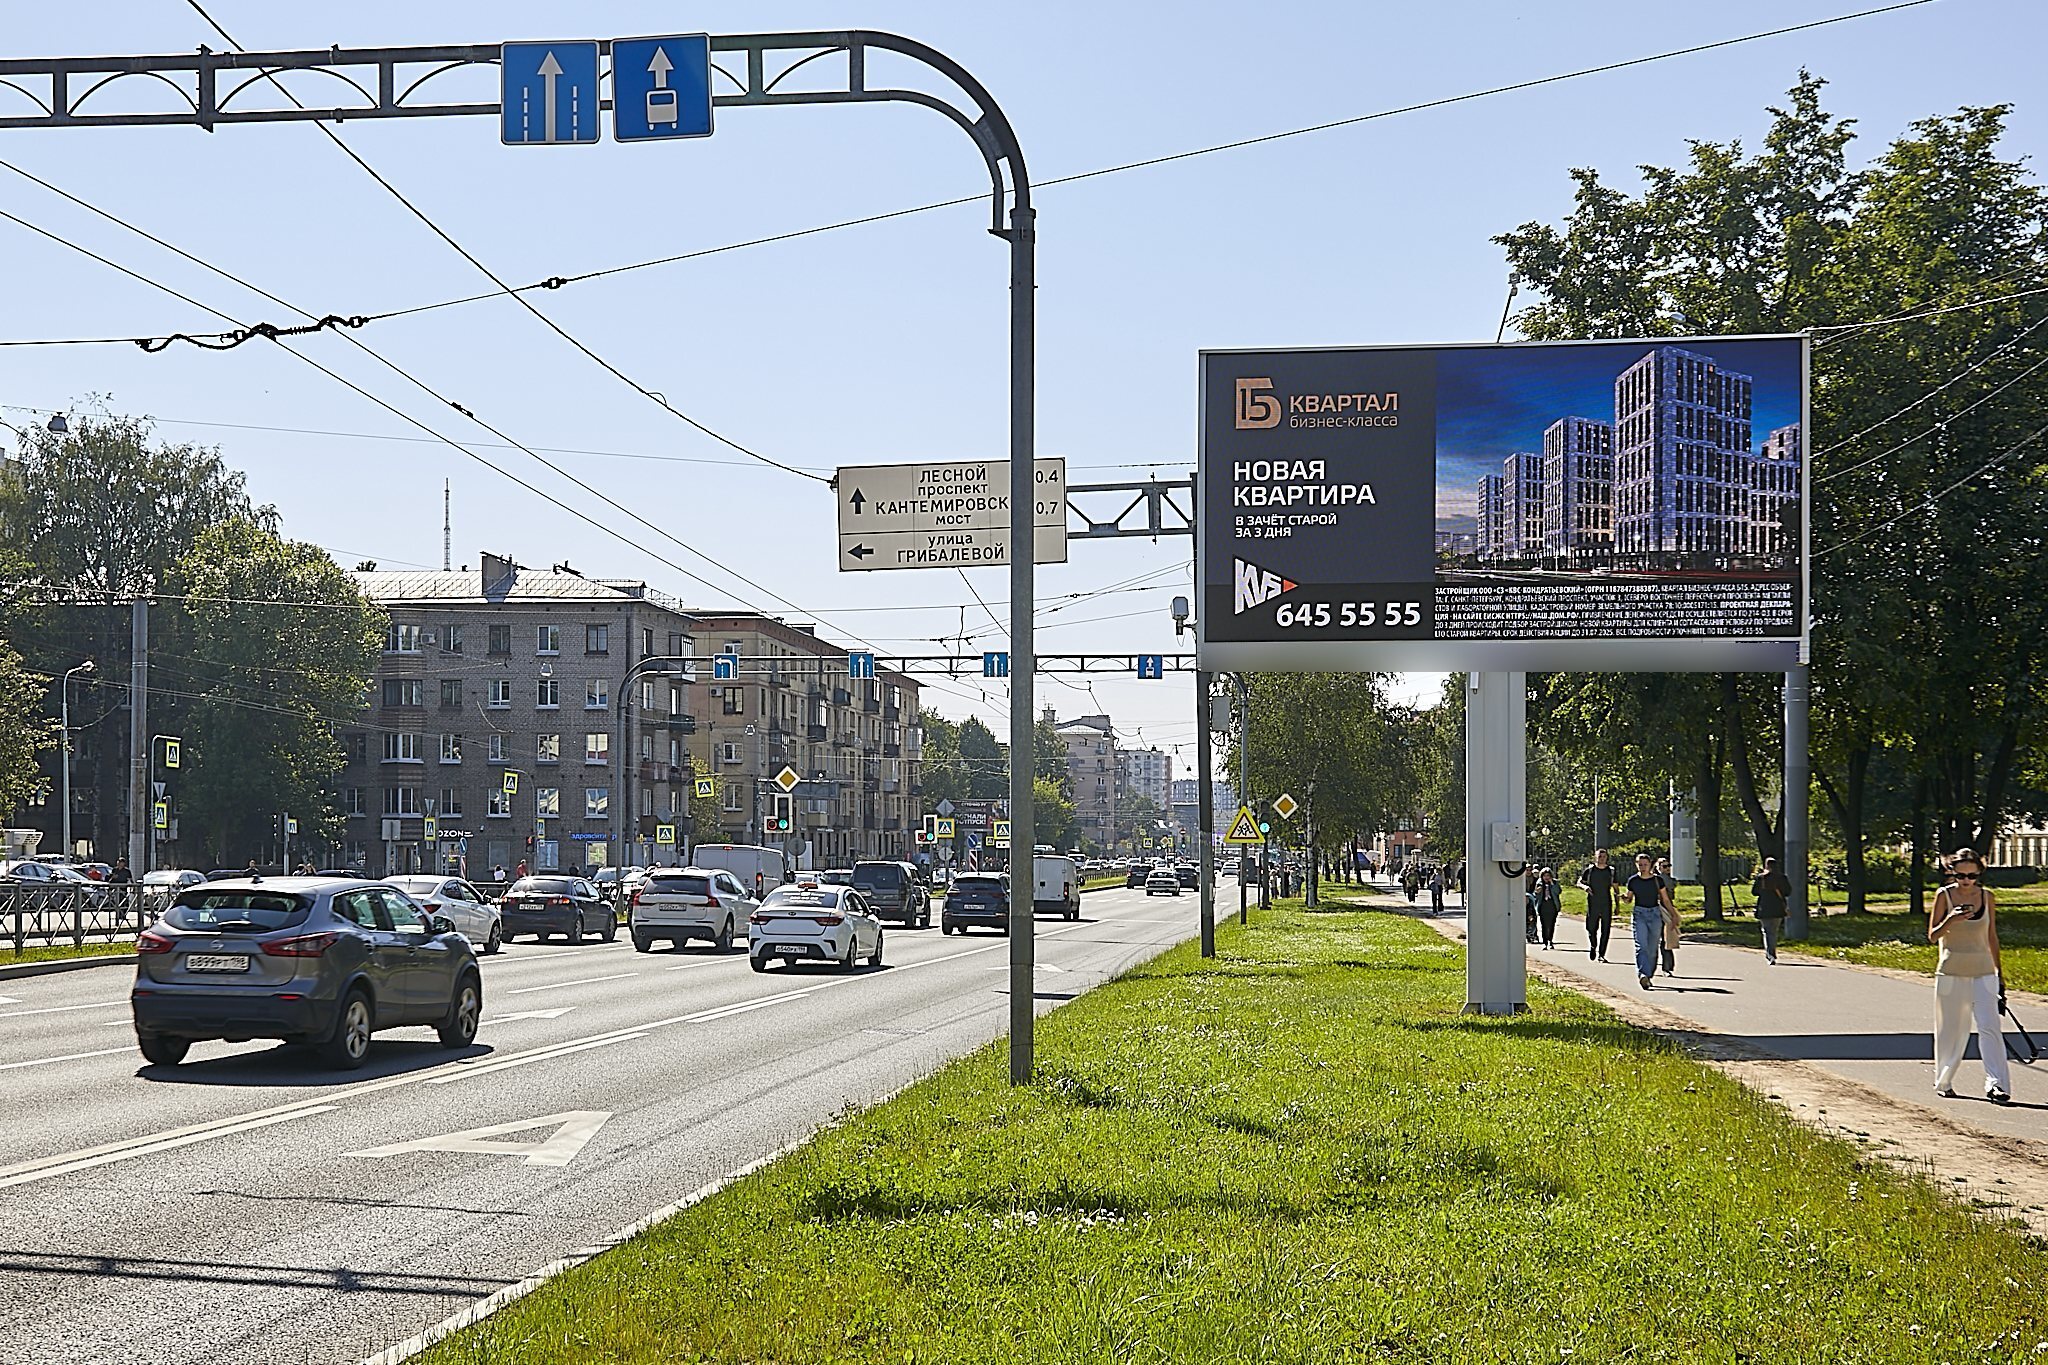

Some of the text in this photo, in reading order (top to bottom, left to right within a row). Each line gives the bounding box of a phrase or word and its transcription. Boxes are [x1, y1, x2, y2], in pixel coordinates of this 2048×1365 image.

[1290, 393, 1398, 413] КВАРТАЛ
[1290, 415, 1398, 428] бизнес-класса
[920, 465, 1059, 484] ЛЕСНОЙ 0,4
[1234, 460, 1325, 481] НОВАЯ
[918, 483, 988, 498] проспект
[1234, 484, 1376, 506] КВАРТИРА
[875, 496, 1059, 515] КАНТЕМИРОВСК 0,7
[936, 514, 972, 525] мост
[1235, 513, 1337, 526] В ЗАЧЁТ СТАРОЙ
[928, 534, 973, 548] улица
[1235, 527, 1292, 539] ЗА 3 ДНЯ
[897, 543, 1004, 563] ГРИБАЛЕВОЙ
[1434, 587, 1479, 595] ЗАСТРОЙЩИК
[1276, 602, 1421, 627] 645 55 55
